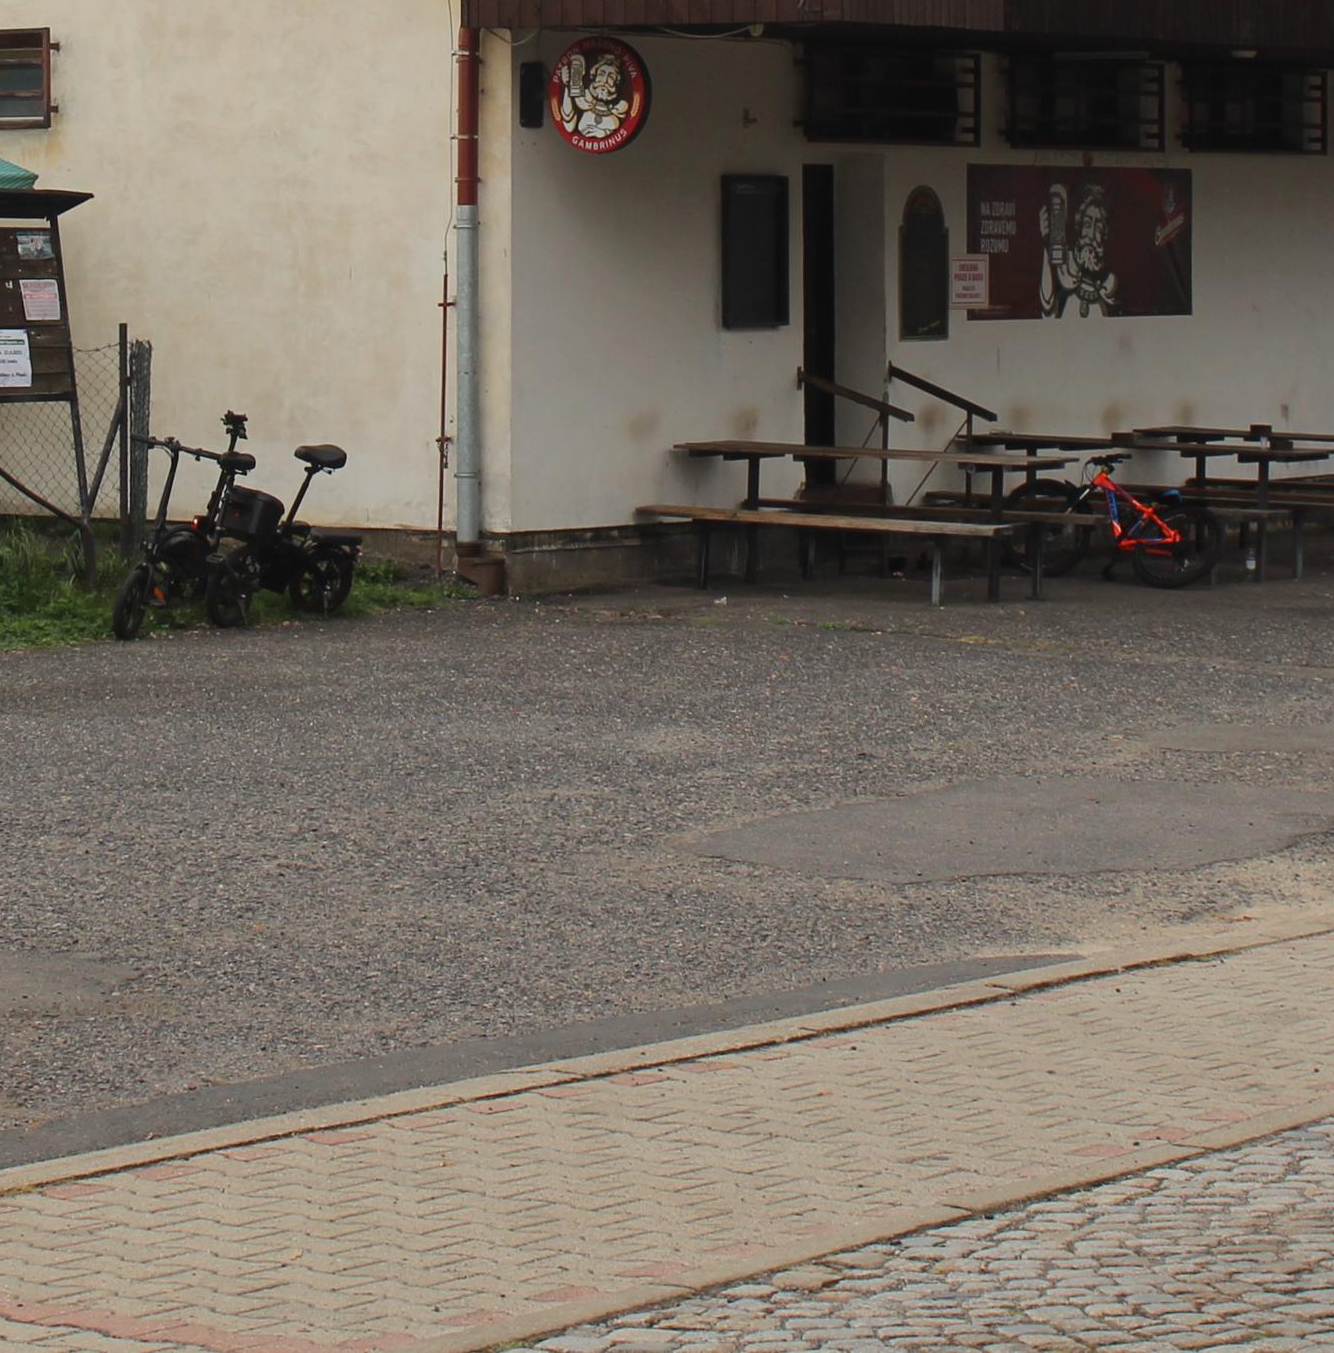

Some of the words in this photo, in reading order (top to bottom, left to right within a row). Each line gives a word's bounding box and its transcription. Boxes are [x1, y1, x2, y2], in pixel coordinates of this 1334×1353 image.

[571, 128, 627, 150] GAMBRINUS
[980, 202, 991, 216] NA
[980, 238, 1009, 254] ROZUMU
